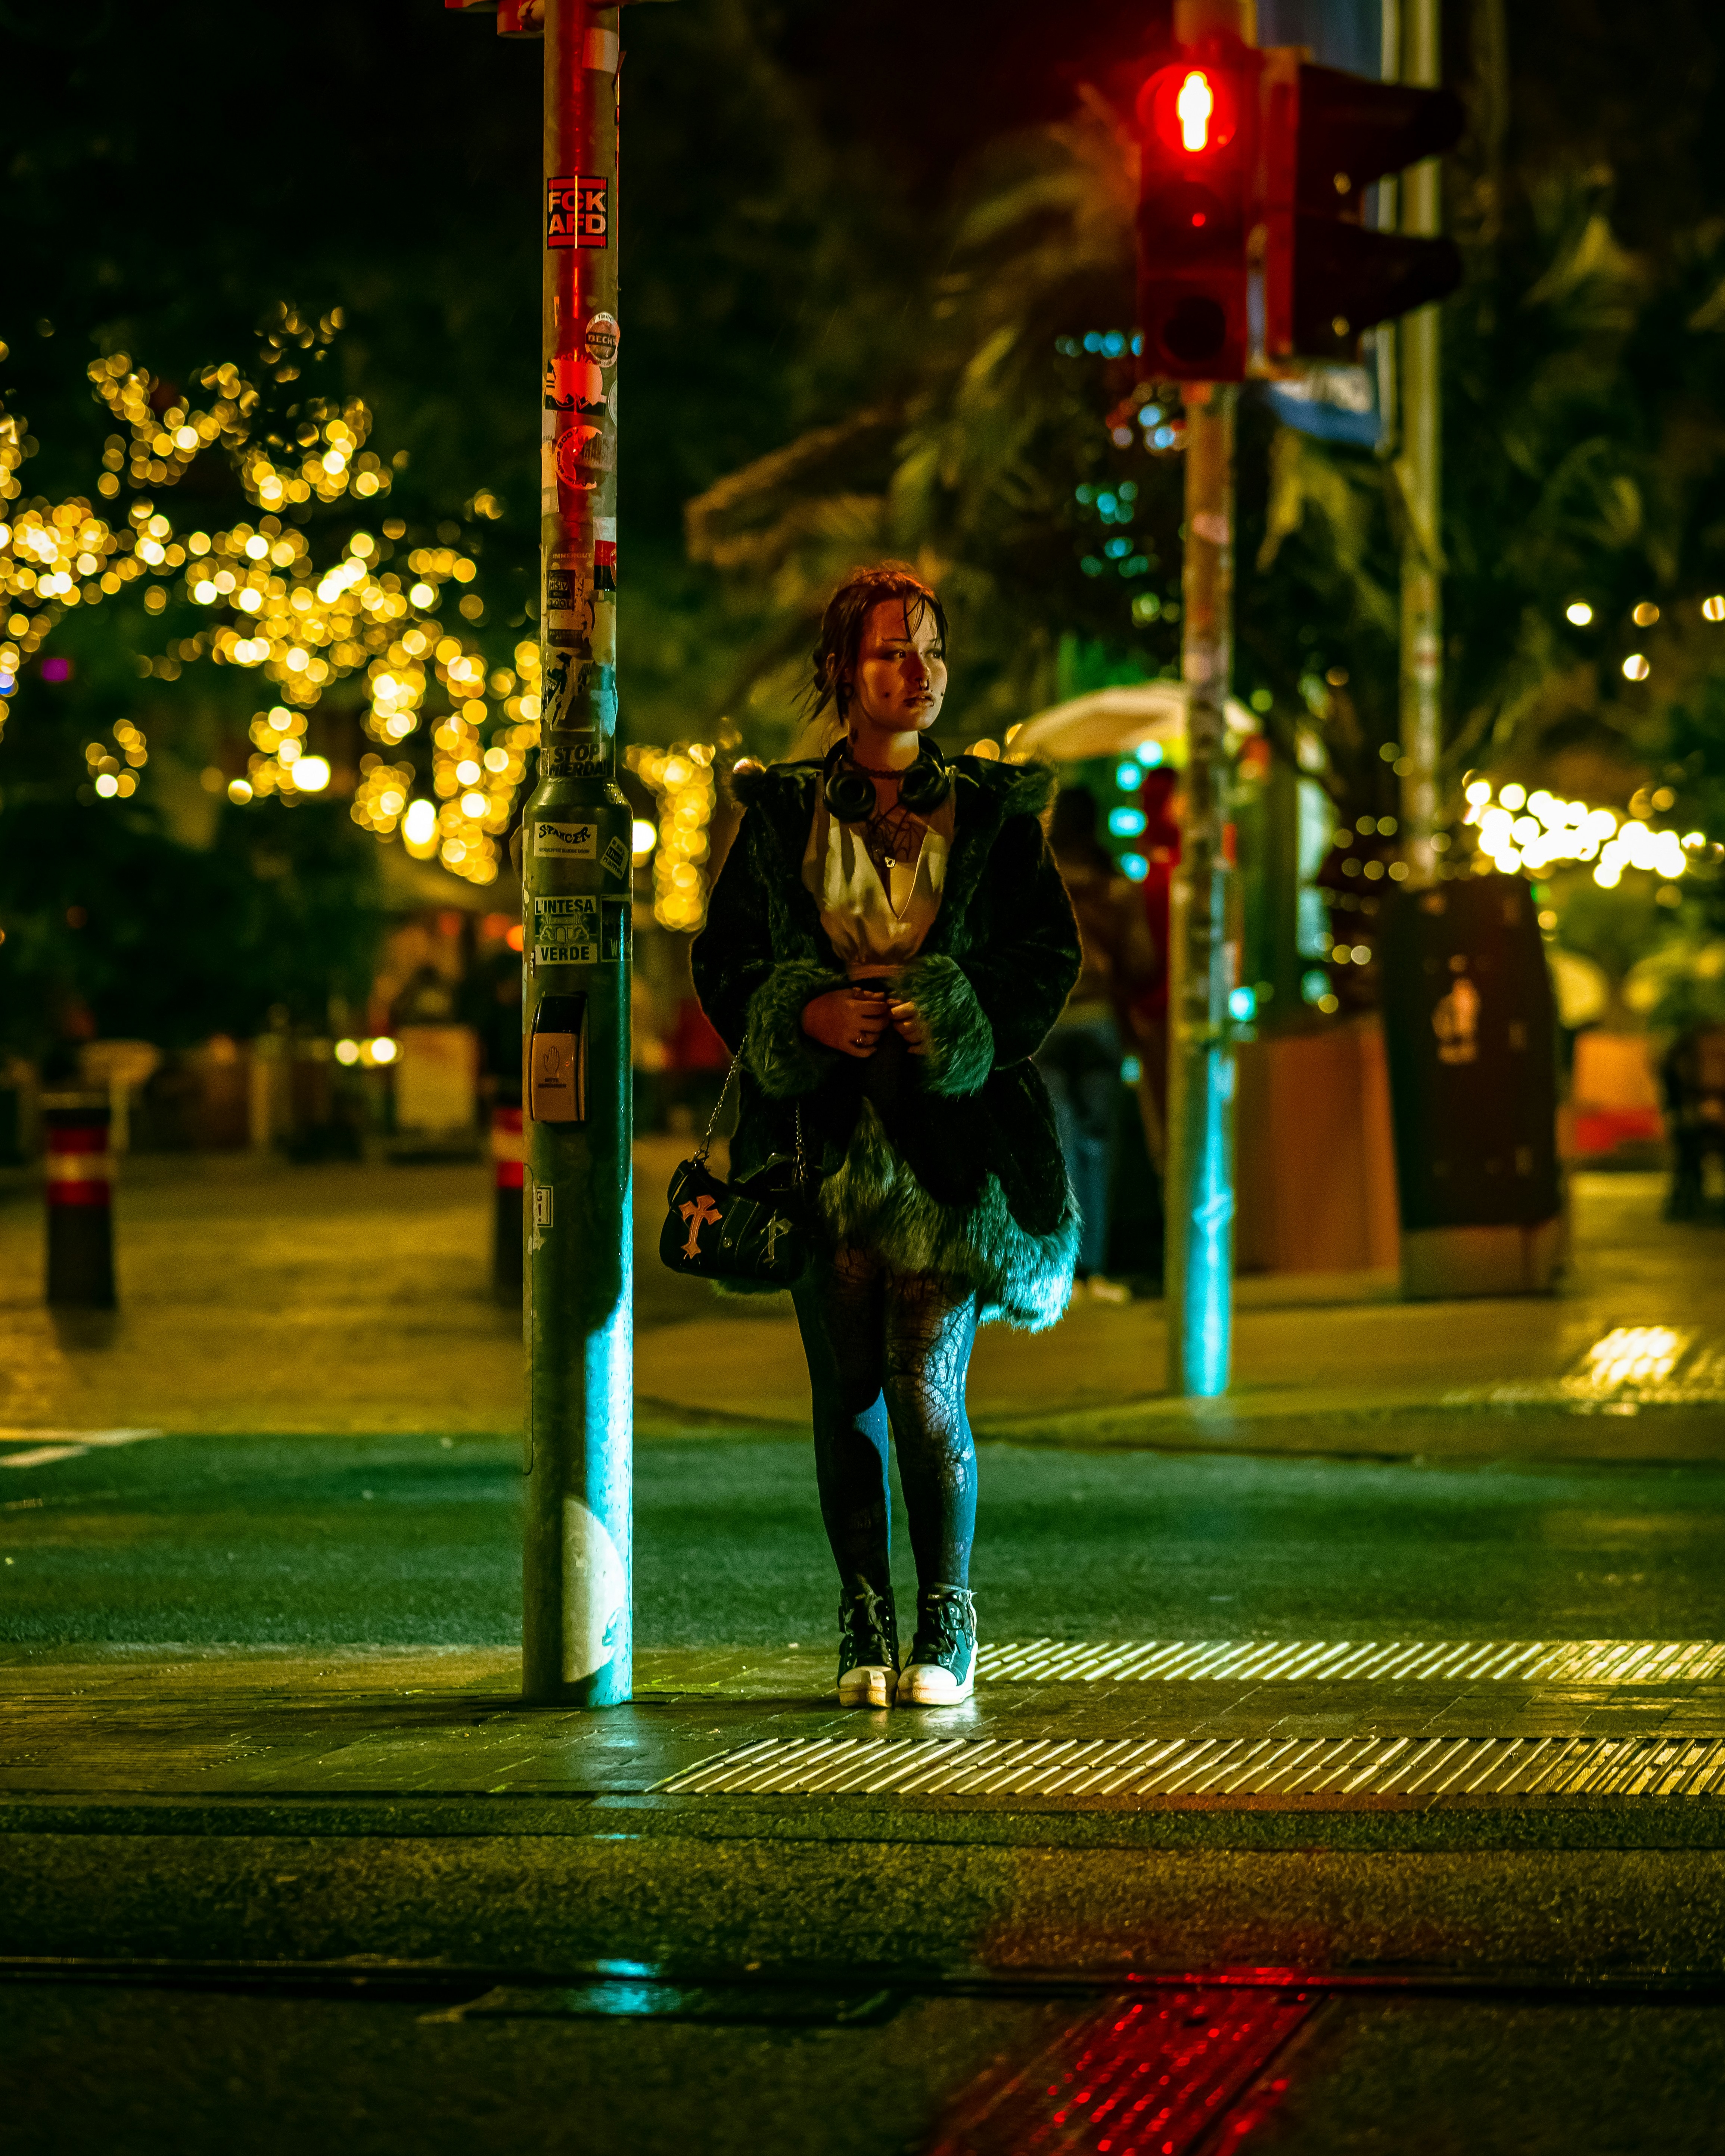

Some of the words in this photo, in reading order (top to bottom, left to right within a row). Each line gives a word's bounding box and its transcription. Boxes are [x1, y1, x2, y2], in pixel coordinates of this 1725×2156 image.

[548, 191, 606, 212] FCK
[548, 214, 606, 234] AFD
[554, 744, 600, 763] STOP
[535, 899, 594, 913] L'INTESA
[541, 946, 590, 961] VERDE
